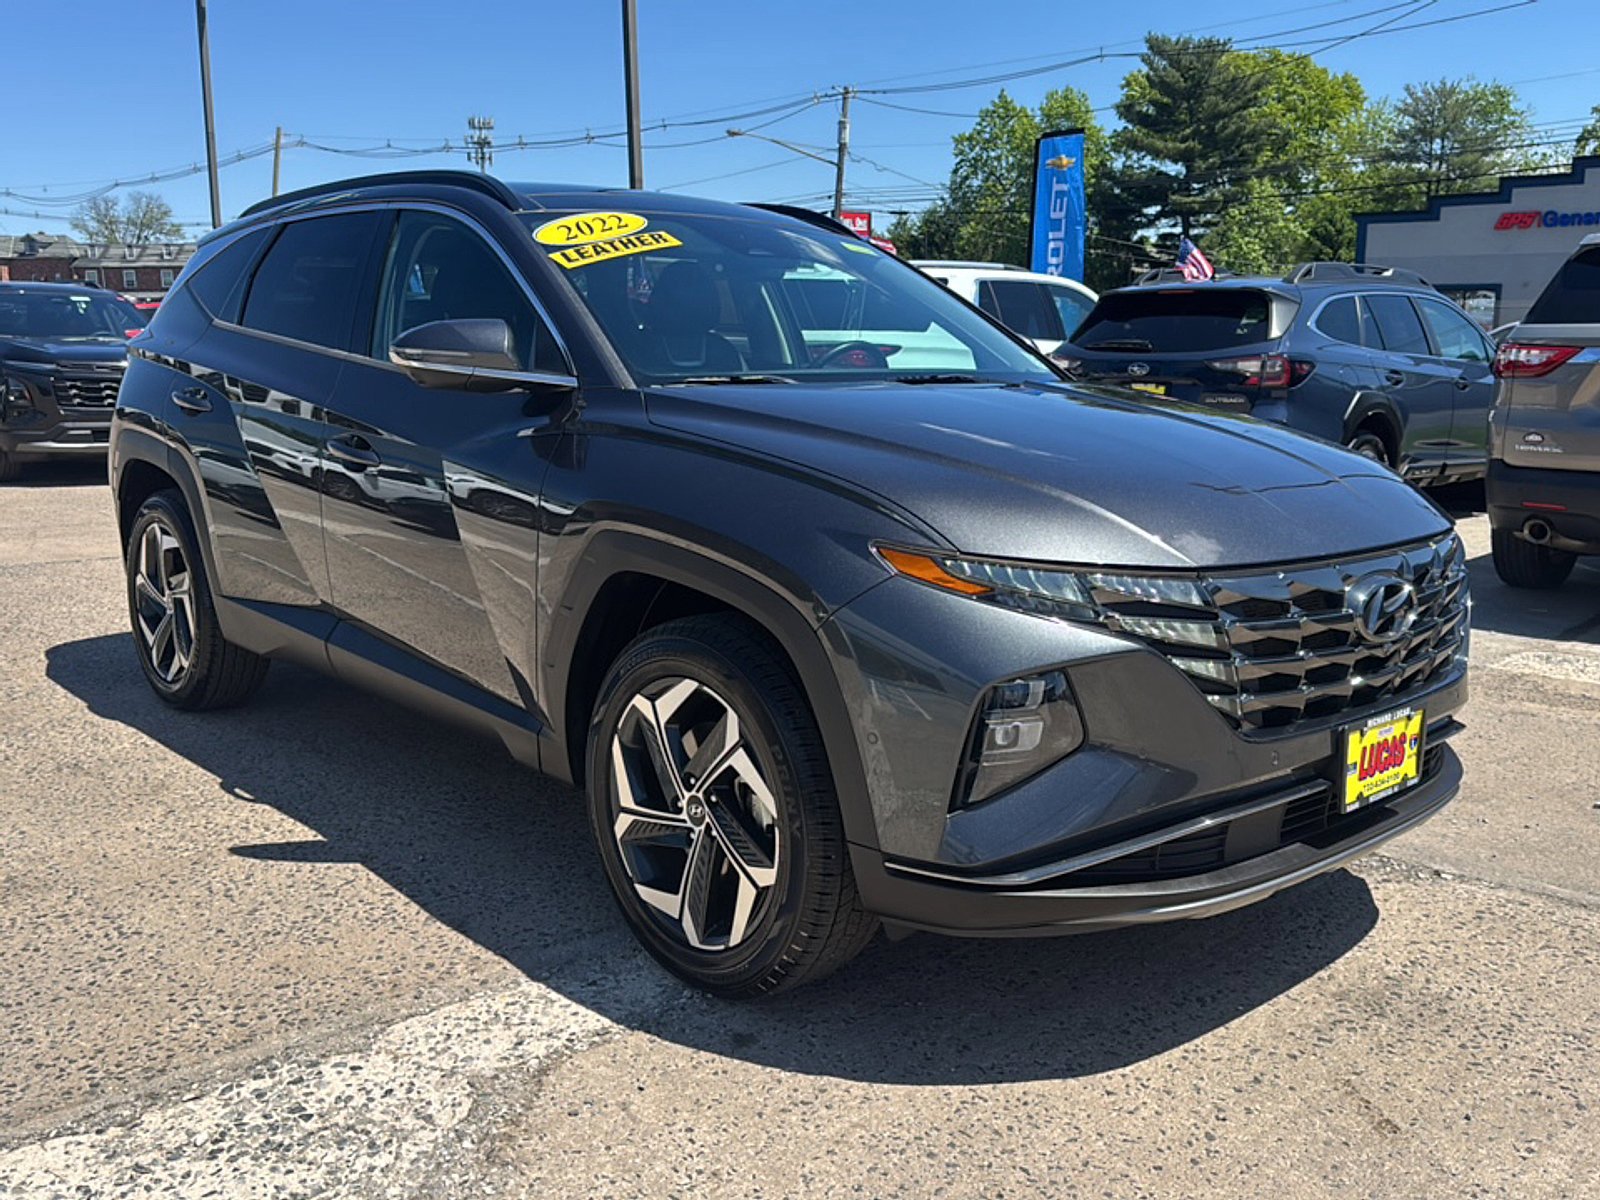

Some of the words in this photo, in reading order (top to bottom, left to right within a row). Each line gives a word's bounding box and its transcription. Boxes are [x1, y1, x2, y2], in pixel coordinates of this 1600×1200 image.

[556, 214, 629, 241] 2022
[560, 233, 669, 263] LEATHER
[1359, 732, 1407, 781] LUCAS
